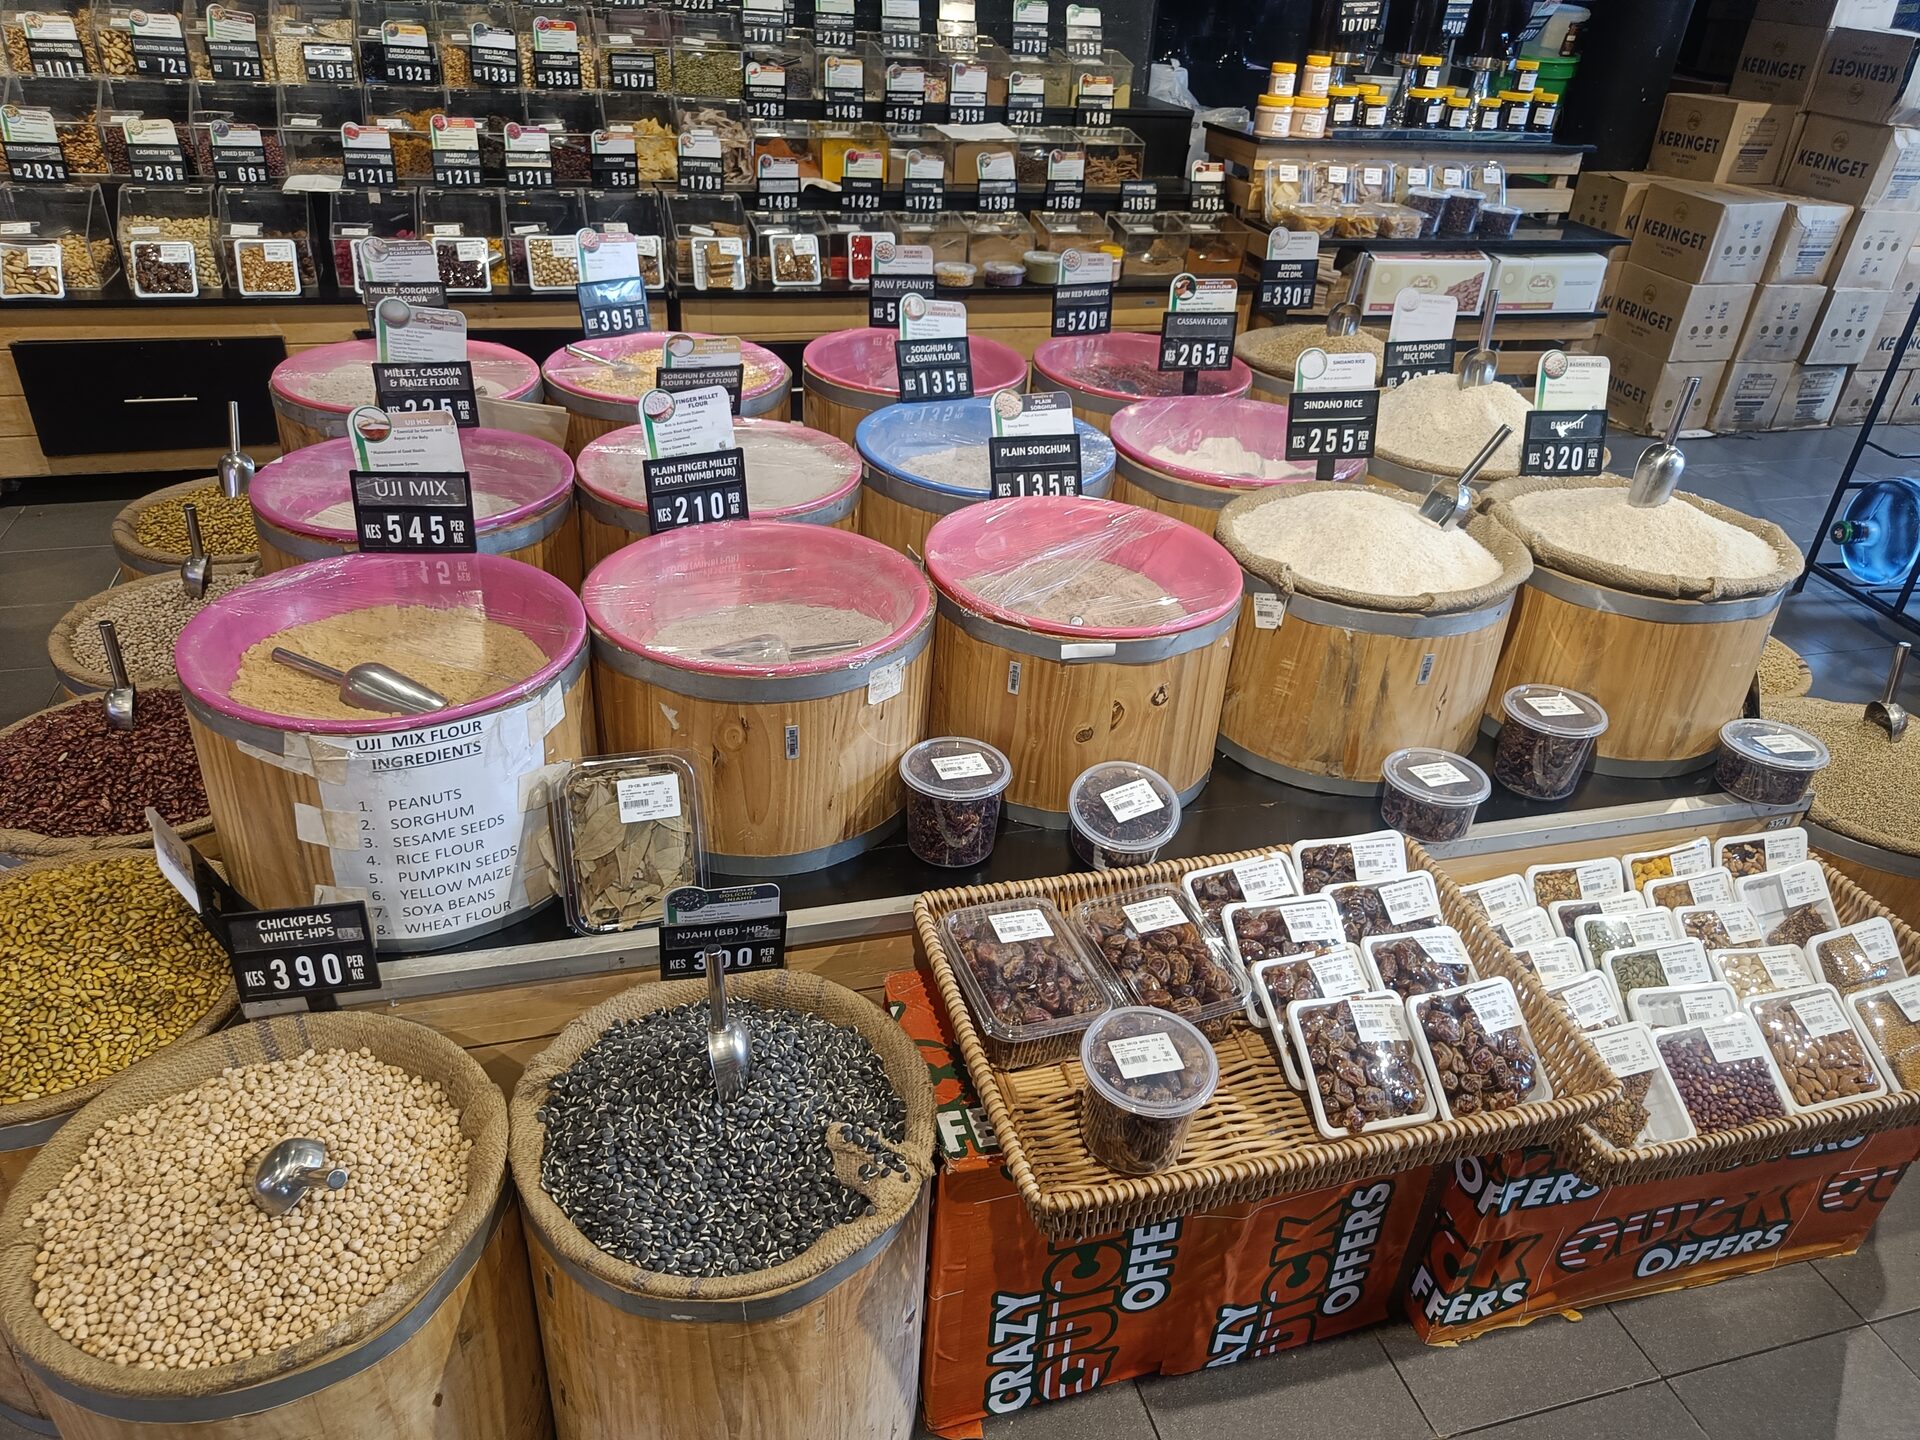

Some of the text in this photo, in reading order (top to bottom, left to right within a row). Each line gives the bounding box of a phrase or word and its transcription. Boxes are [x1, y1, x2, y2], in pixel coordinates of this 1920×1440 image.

[1342, 18, 1370, 32] 1070
[753, 29, 774, 41] 171
[824, 32, 846, 45] 212
[892, 36, 911, 50] 151
[1021, 40, 1040, 52] 173
[1076, 43, 1094, 55] 135
[46, 60, 74, 78] 101
[158, 58, 177, 73] 72
[232, 62, 251, 76] 72
[318, 64, 344, 79] 195
[1741, 56, 1806, 80] KERINGET
[1828, 58, 1898, 83] KERINGET
[397, 66, 422, 80] 132
[483, 66, 507, 82] 133
[546, 71, 571, 85] 353
[623, 73, 646, 87] 167
[755, 103, 777, 116] 126
[835, 106, 856, 118] 146
[894, 108, 914, 121] 156
[958, 109, 978, 122] 313
[1016, 110, 1035, 123] 221
[1086, 112, 1104, 124] 148
[1659, 130, 1720, 154] KERINGET
[23, 163, 55, 179] 282
[1798, 149, 1868, 179] KERINGET
[144, 166, 174, 181] 258
[238, 166, 256, 182] 66
[358, 168, 383, 183] 121
[446, 170, 471, 184] 121
[518, 171, 542, 185] 121
[612, 172, 627, 185] 55
[690, 175, 713, 190] 178
[768, 195, 790, 208] 148
[851, 195, 873, 208] 142
[915, 196, 935, 209] 172
[988, 196, 1008, 210] 139
[1055, 196, 1074, 209] 156
[1130, 197, 1150, 210] 165
[1200, 198, 1218, 210] 143
[1643, 218, 1706, 251] KERINGET
[370, 286, 440, 296] MILLET, SORGHUM
[874, 280, 934, 290] RAW PEANUTS
[1057, 290, 1069, 298] RAW
[1082, 288, 1109, 297] PEANUTS
[1273, 287, 1301, 305] 330
[587, 309, 633, 331] KES 395
[1067, 310, 1098, 331] 520
[1177, 317, 1228, 325] CASSAVA FLOUR
[1616, 297, 1673, 332] KERINGET
[911, 344, 947, 354] SORGHUM
[1165, 343, 1216, 366] KES 265
[1396, 342, 1445, 353] MWEA PISHORI
[905, 352, 960, 363] CASSAVA FLOUR
[384, 367, 462, 378] MILLET, CASSAVA
[707, 370, 738, 379] CASSAVA
[390, 376, 459, 387] & MAIZE FLOUR
[693, 378, 713, 386] MAIZE
[904, 370, 956, 394] KES 135
[675, 392, 718, 405] FINGER MILLET
[688, 400, 708, 409] FLOUR
[1303, 399, 1363, 410] SINDANO RICE
[1292, 428, 1354, 453] KES 255
[1358, 430, 1369, 441] PER
[1000, 444, 1071, 457] PLAIN SORGHUM
[1528, 446, 1582, 470] KES 320
[650, 457, 738, 476] PLAIN FINGER MILLET
[655, 467, 736, 486] FLOUR (WIMBI PUR)
[374, 480, 448, 497] UJI MIX
[1016, 473, 1059, 497] 135
[675, 492, 725, 523] 210
[365, 514, 445, 545] KES 545
[450, 520, 465, 532] PER
[454, 532, 464, 544] KG
[356, 721, 482, 751] UJI MIX FLOUR
[372, 740, 482, 770] INGREDIENTS
[389, 788, 462, 811] PEANUTS
[391, 804, 475, 830] SORGHUM
[393, 814, 505, 848] SESAME SEEDS
[396, 839, 485, 864] RICE FLOUR
[398, 845, 518, 882] PUMPKIN SEEDS
[400, 865, 512, 900] YELLOW MAIZE
[402, 888, 496, 917] SOYA BEANS
[258, 913, 332, 931] CHICKPEAS
[405, 900, 512, 934] WHEAT FLOUR
[259, 926, 335, 944] WHITE-HPS
[677, 930, 712, 940] NJAHI
[714, 927, 739, 938] (BB)
[269, 953, 343, 990] 390
[1322, 1182, 1391, 1316] OFFERS
[1636, 1223, 1790, 1278] OFFERS
[986, 1292, 1042, 1415] CRAZY
